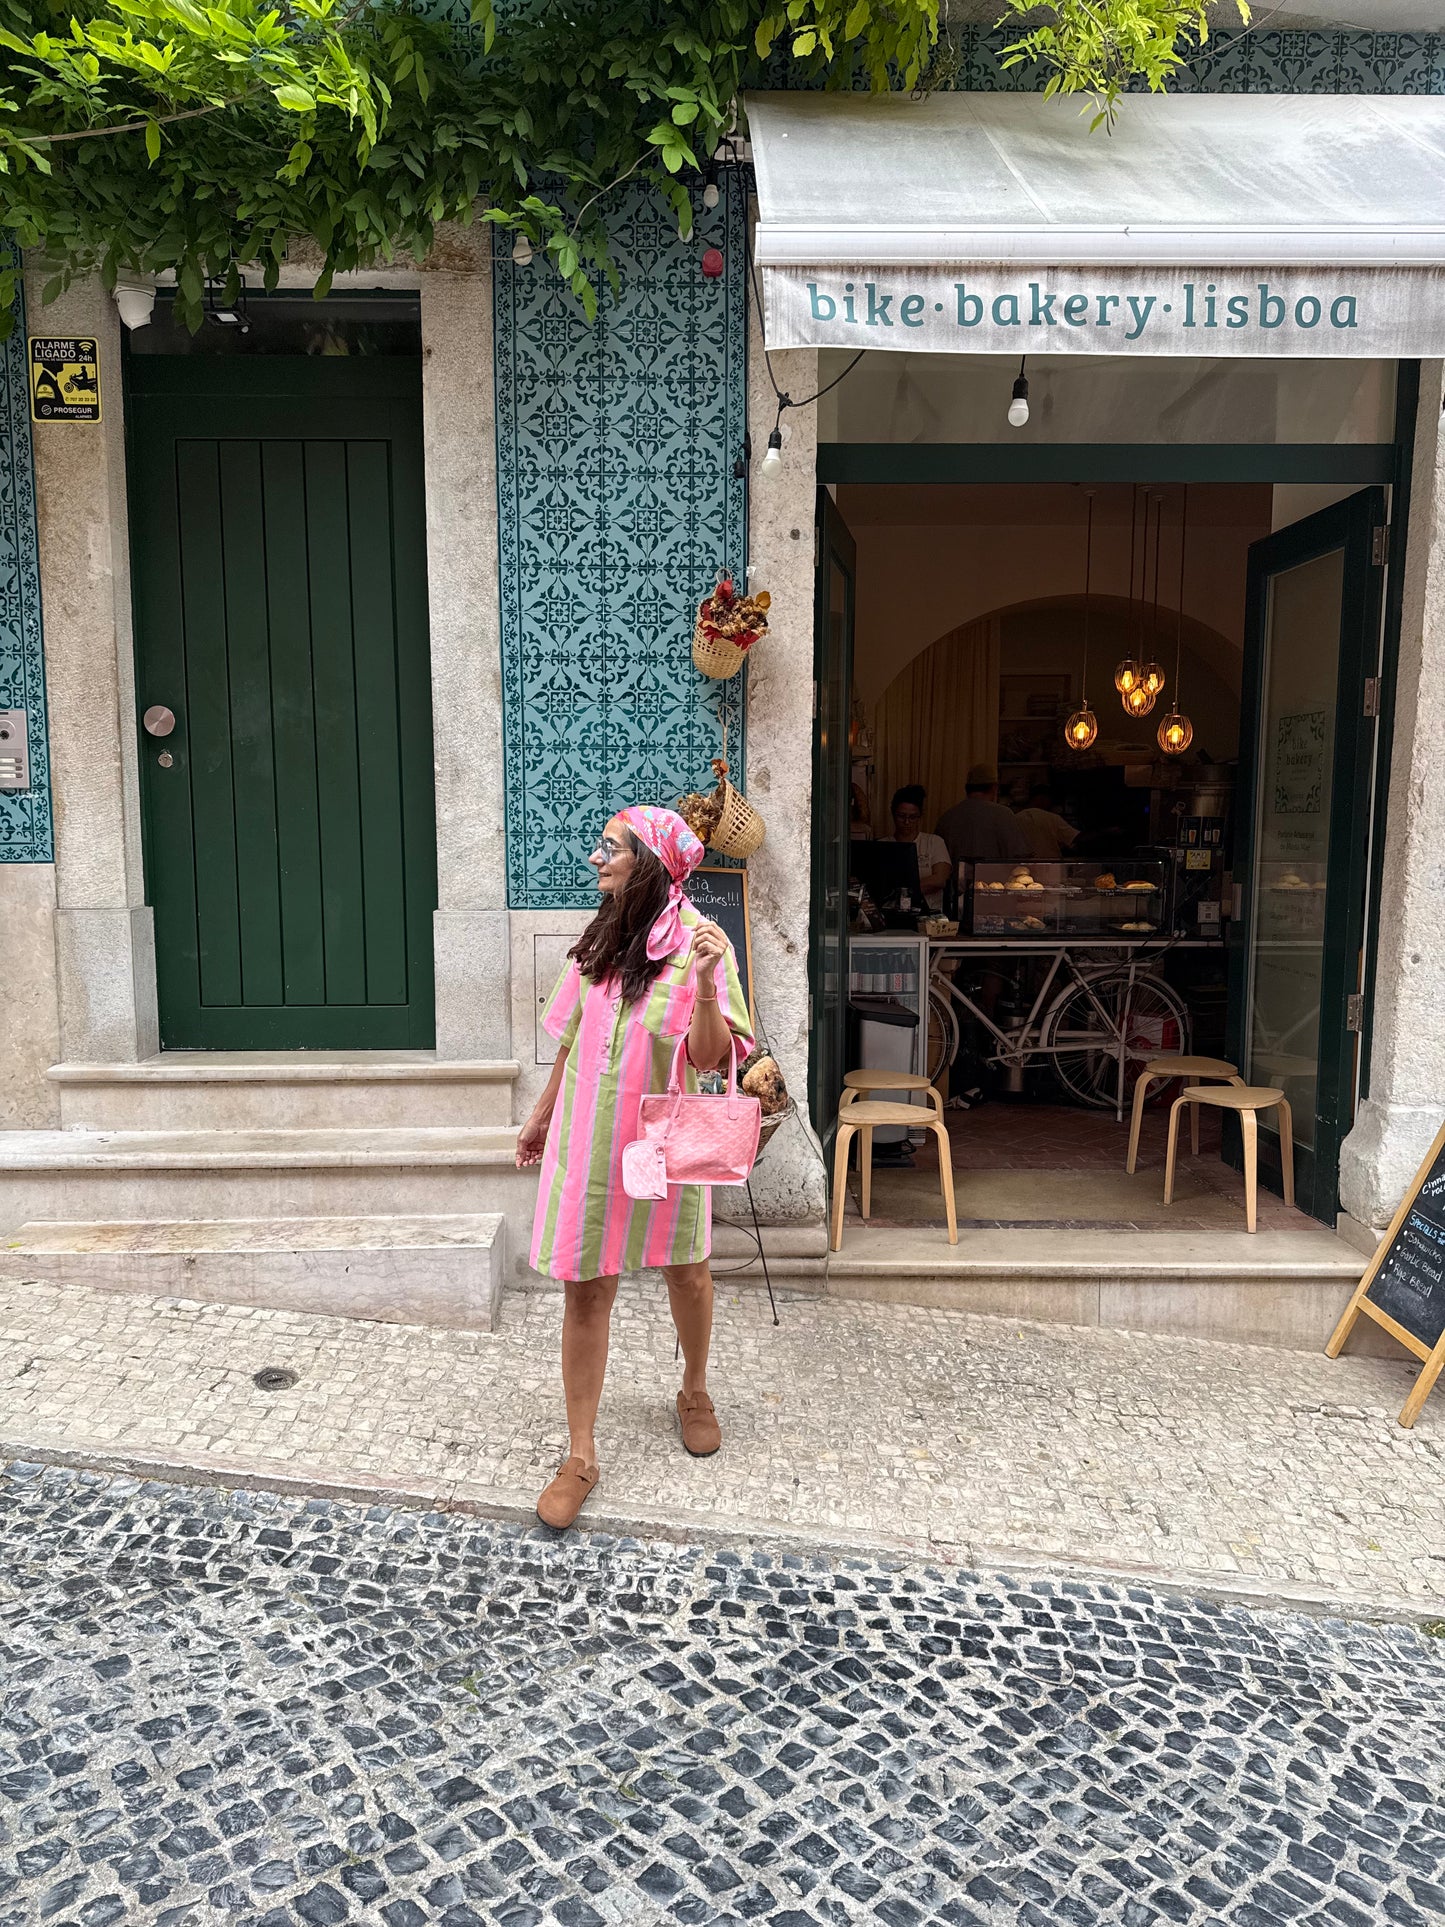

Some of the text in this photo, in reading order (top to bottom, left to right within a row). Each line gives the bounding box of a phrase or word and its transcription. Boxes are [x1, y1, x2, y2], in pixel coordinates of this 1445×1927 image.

[35, 341, 75, 349] ALARME
[35, 349, 76, 358] LIGADO
[78, 354, 93, 362] 24h
[53, 406, 93, 414] PROSEGUR
